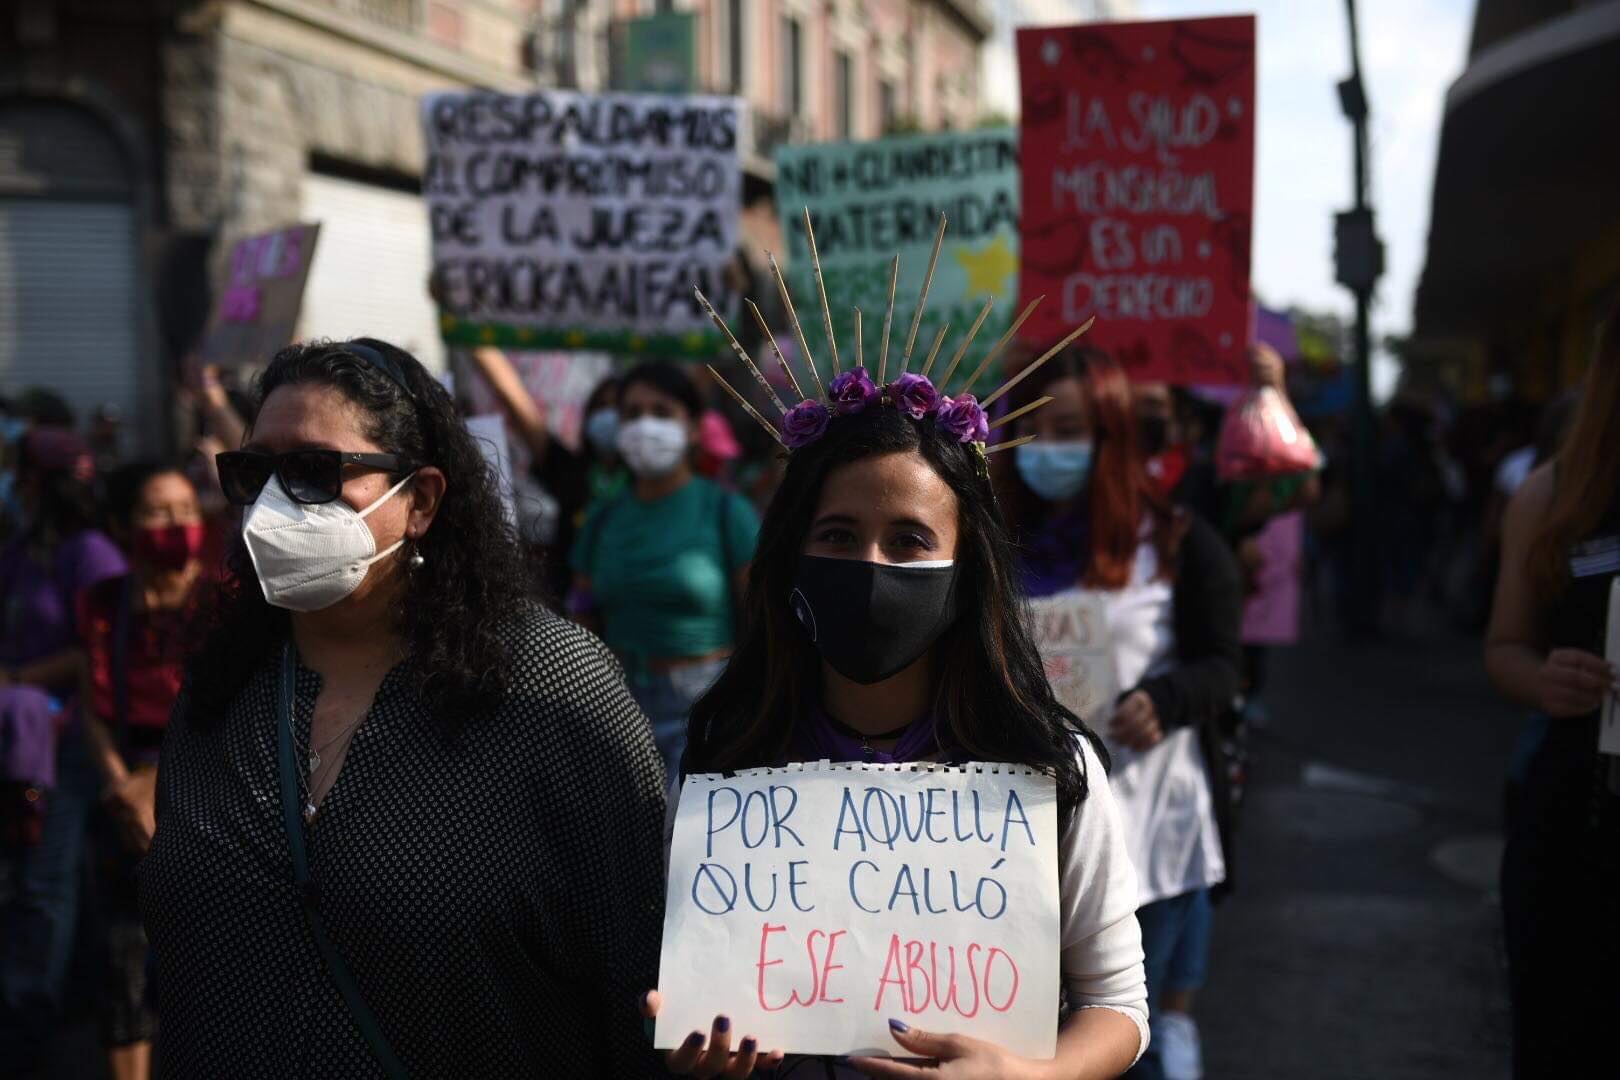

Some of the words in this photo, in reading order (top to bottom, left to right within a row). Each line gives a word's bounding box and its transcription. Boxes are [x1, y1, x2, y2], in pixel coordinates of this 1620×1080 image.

[433, 94, 737, 149] RESPALDAMOS
[1062, 94, 1117, 150] LA
[1121, 91, 1220, 163] SALUD
[464, 151, 725, 197] COMPROMISO
[432, 203, 480, 246] DE
[501, 204, 560, 246] LA
[571, 206, 725, 252] JUEZA
[1090, 218, 1136, 269] ES
[1062, 272, 1214, 325] DERECHO
[706, 785, 805, 857] POR
[833, 785, 1036, 852] AQUELLA
[691, 860, 815, 916] QUE
[849, 857, 1007, 920] CALLÓ
[755, 922, 848, 1012] ESE
[873, 934, 1020, 1018] ABUSO
